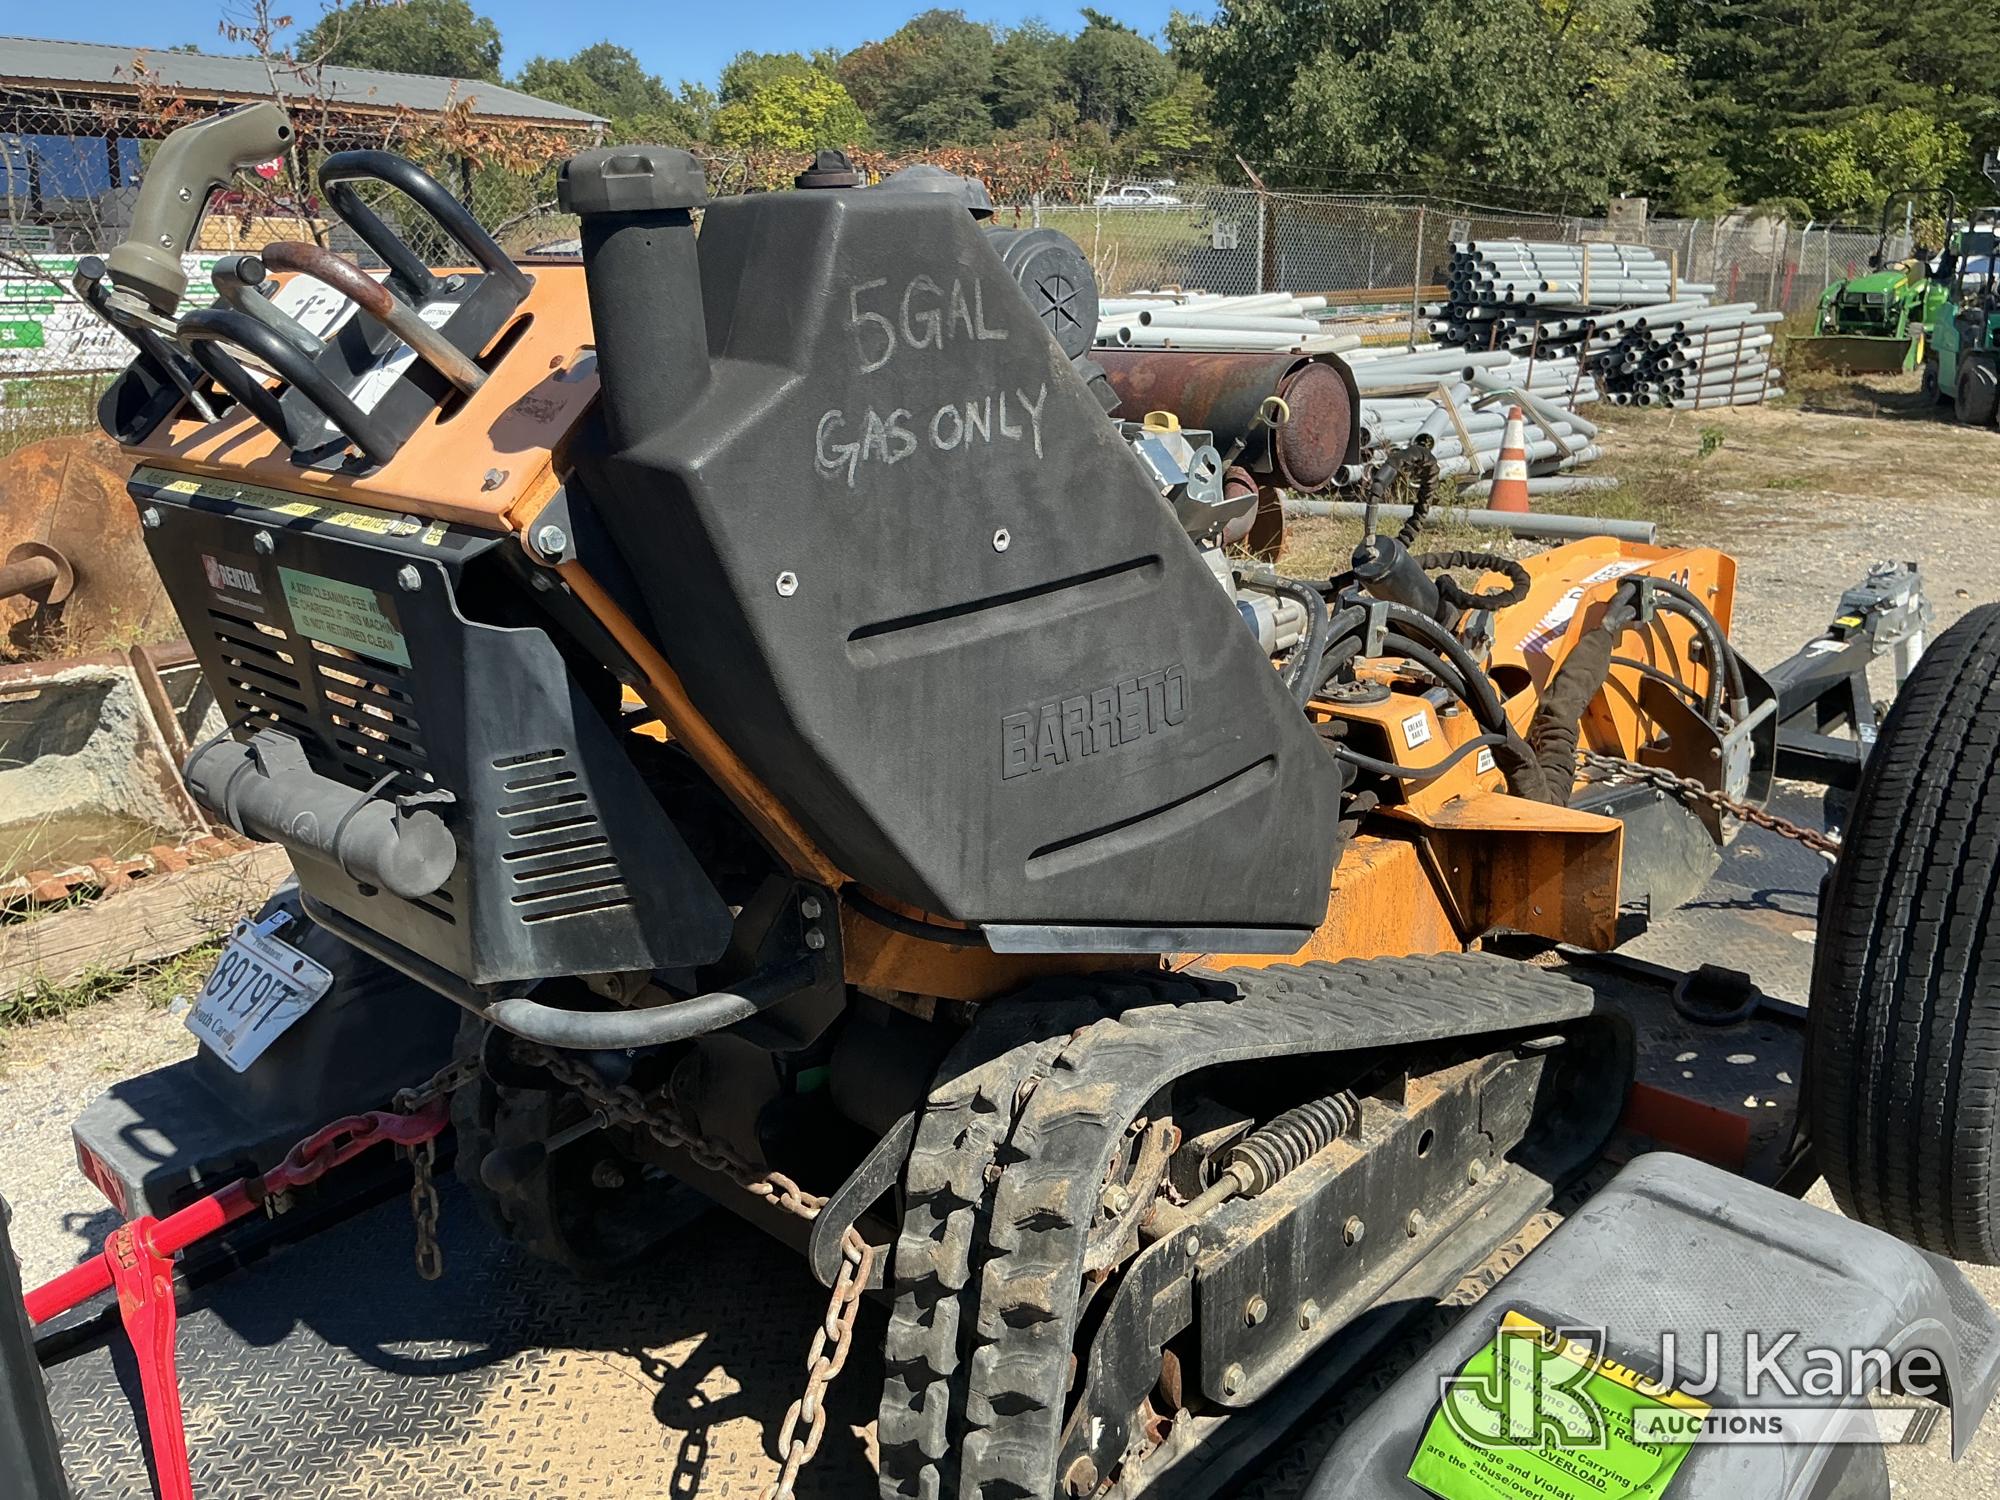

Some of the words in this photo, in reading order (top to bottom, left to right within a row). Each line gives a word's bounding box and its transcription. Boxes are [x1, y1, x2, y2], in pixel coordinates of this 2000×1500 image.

[814, 404, 918, 488] GAS
[929, 382, 1048, 460] ONLY
[218, 563, 262, 595] RENTAL
[289, 595, 300, 609] BE
[300, 598, 335, 618] CHARGED
[344, 609, 363, 626] THIS
[363, 614, 400, 637] MACHIN
[313, 587, 351, 607] CLEANING
[351, 595, 368, 611] FEE
[302, 615, 309, 628] IS
[309, 617, 326, 631] NOT
[326, 621, 367, 643] RETURNED
[367, 634, 395, 651] CLEAN
[1000, 662, 1187, 780] BARRETO
[1407, 719, 1424, 733] GREASE
[1411, 728, 1424, 740] DAILY
[252, 938, 284, 961] Permanent
[192, 1003, 213, 1028] South
[1491, 1347, 1533, 1376] Trailer
[1497, 1367, 1521, 1386] The
[1524, 1383, 1565, 1409] Home
[1613, 1427, 1663, 1457] Rental
[1455, 1389, 1475, 1405] Not
[1577, 1453, 1631, 1489] Carrying
[1426, 1444, 1446, 1459] are
[1448, 1454, 1467, 1470] the
[1489, 1422, 1508, 1436] DO
[1510, 1433, 1538, 1452] NOT
[1538, 1448, 1608, 1492] OVERLOAD.
[1506, 1462, 1531, 1480] and
[1533, 1474, 1576, 1500] Violati
